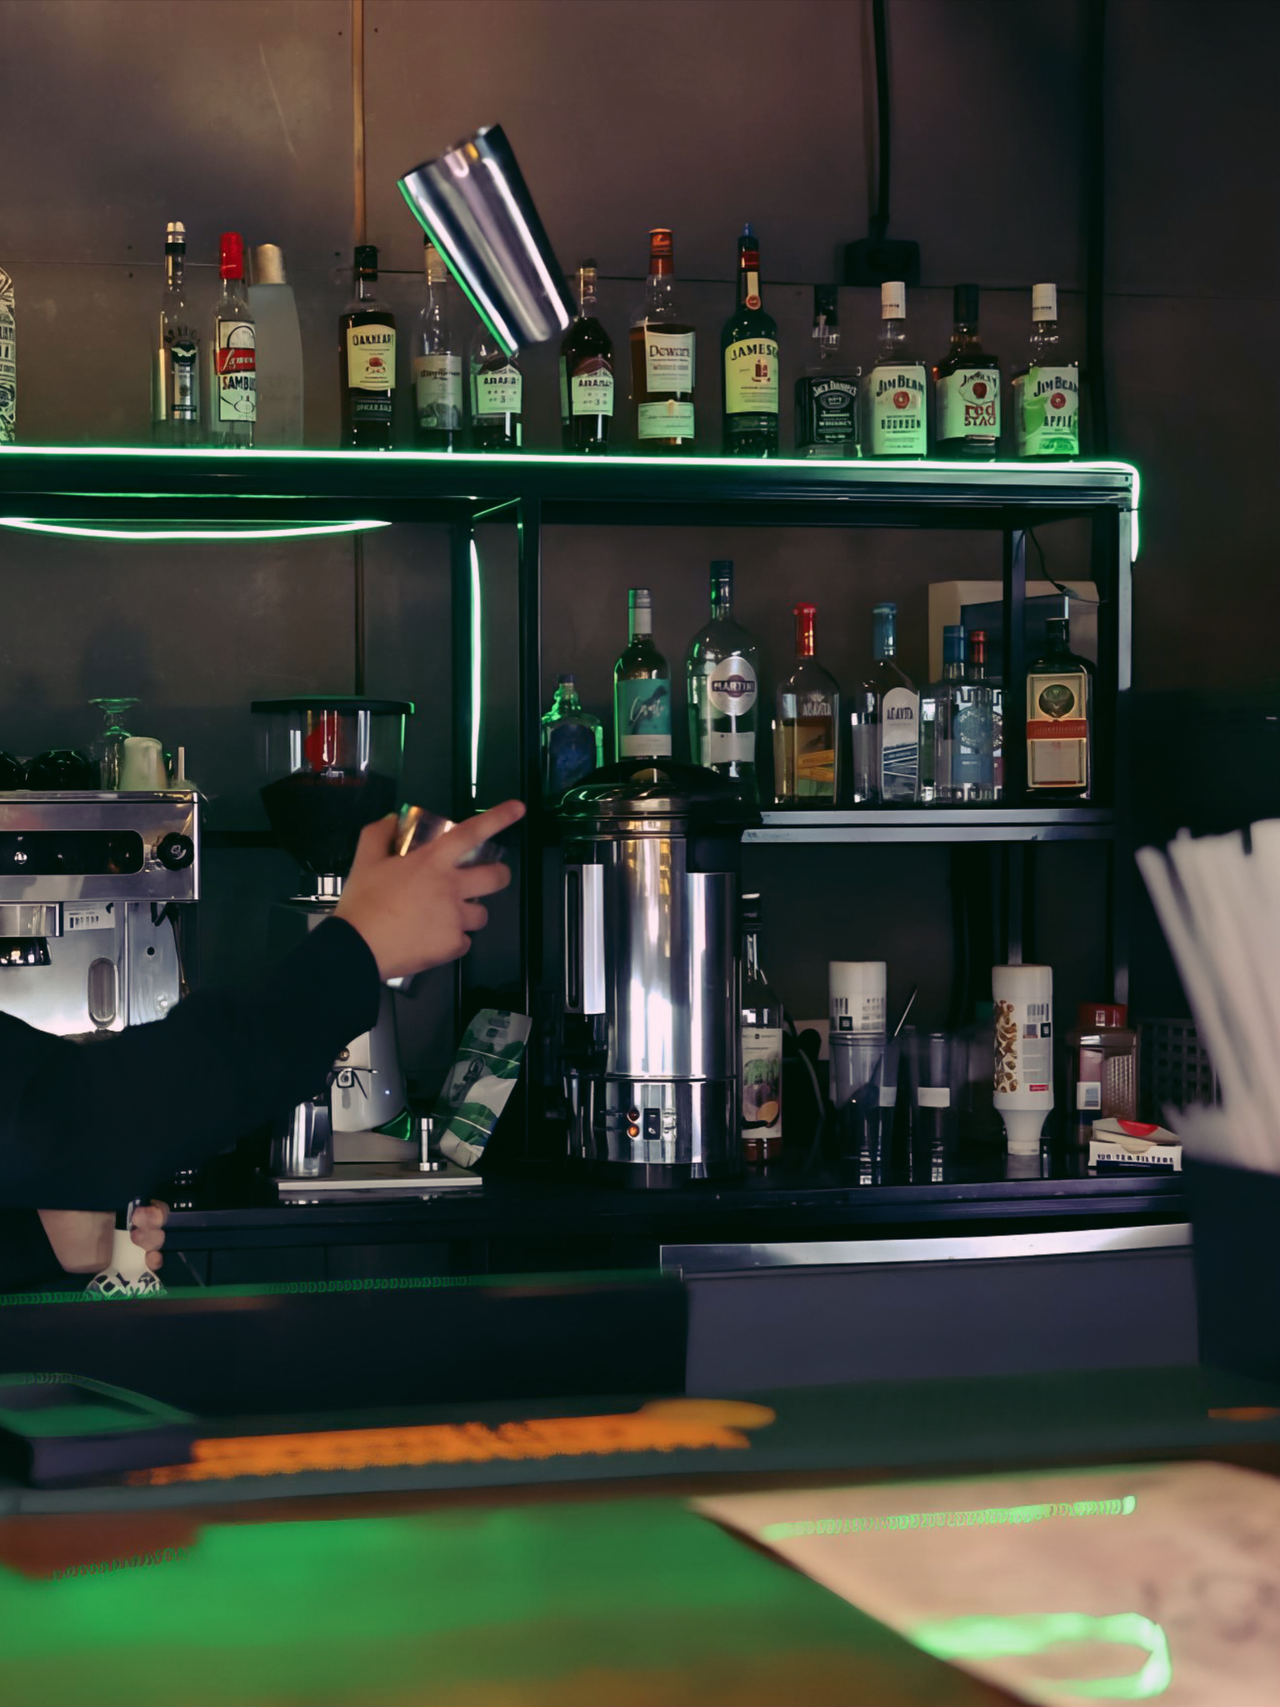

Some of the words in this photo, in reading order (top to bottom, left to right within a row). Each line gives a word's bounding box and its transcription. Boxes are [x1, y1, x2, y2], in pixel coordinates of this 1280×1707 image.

[876, 379, 897, 397] JIM
[1033, 380, 1054, 397] JIM
[713, 682, 755, 691] MARTINI
